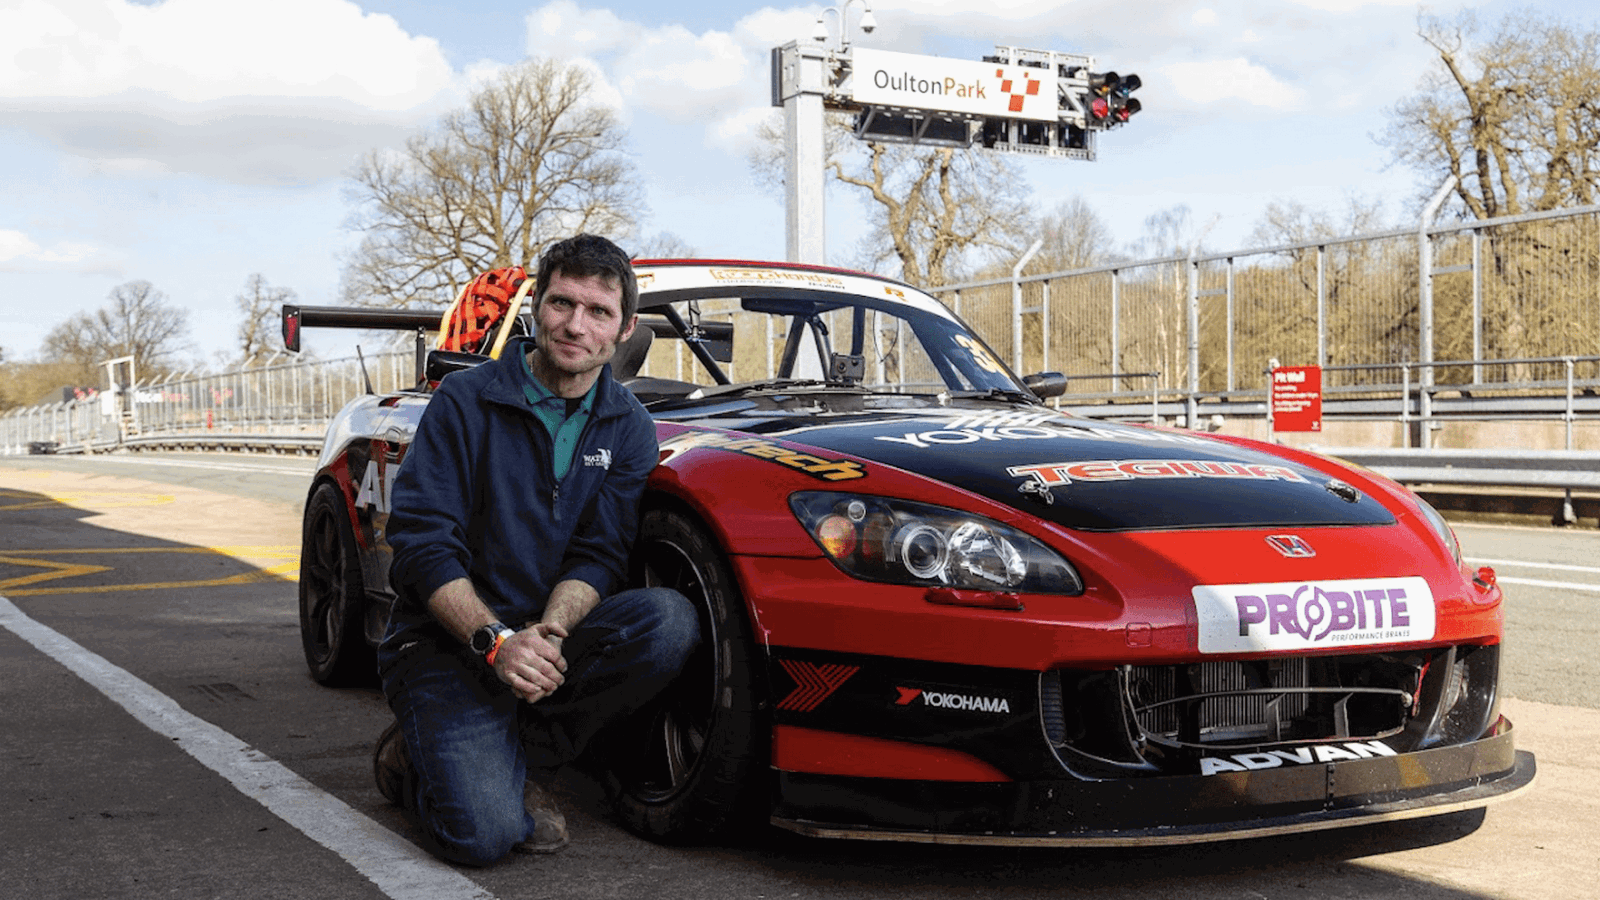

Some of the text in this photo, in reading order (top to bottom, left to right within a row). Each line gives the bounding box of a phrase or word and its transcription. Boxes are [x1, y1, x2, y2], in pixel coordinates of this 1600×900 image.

[1006, 460, 1311, 485] TEGIWA
[1235, 585, 1410, 641] PROBITE
[1331, 631, 1383, 642] PERFORMANCE
[922, 691, 1010, 713] YOKOHAMA
[1200, 740, 1398, 776] ADVAN
